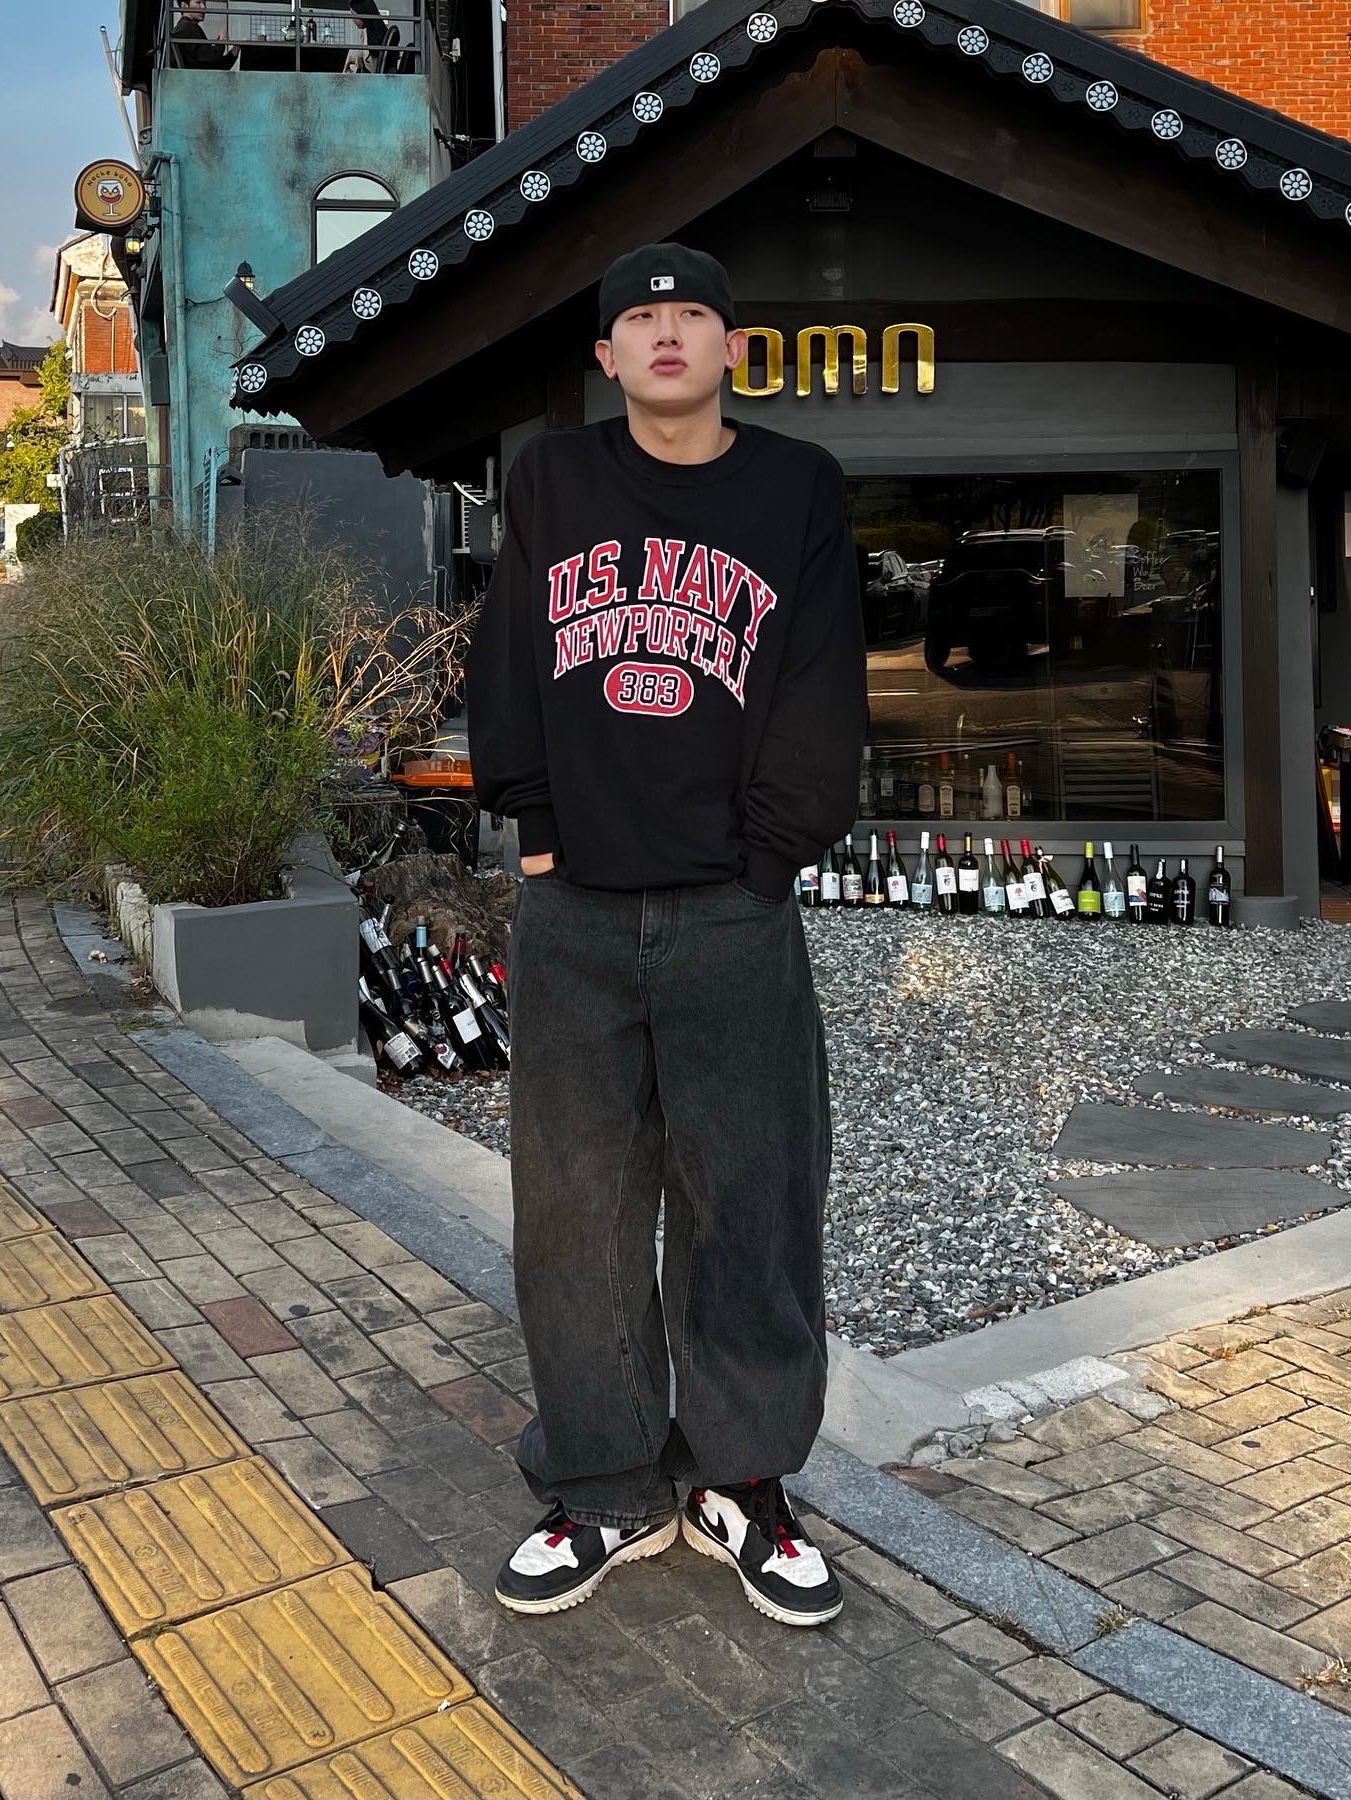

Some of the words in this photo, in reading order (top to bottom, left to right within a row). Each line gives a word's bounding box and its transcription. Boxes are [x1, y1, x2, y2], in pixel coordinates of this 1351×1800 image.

[549, 539, 627, 625] U.S.
[638, 537, 778, 651] NAVY
[618, 669, 681, 708] 383
